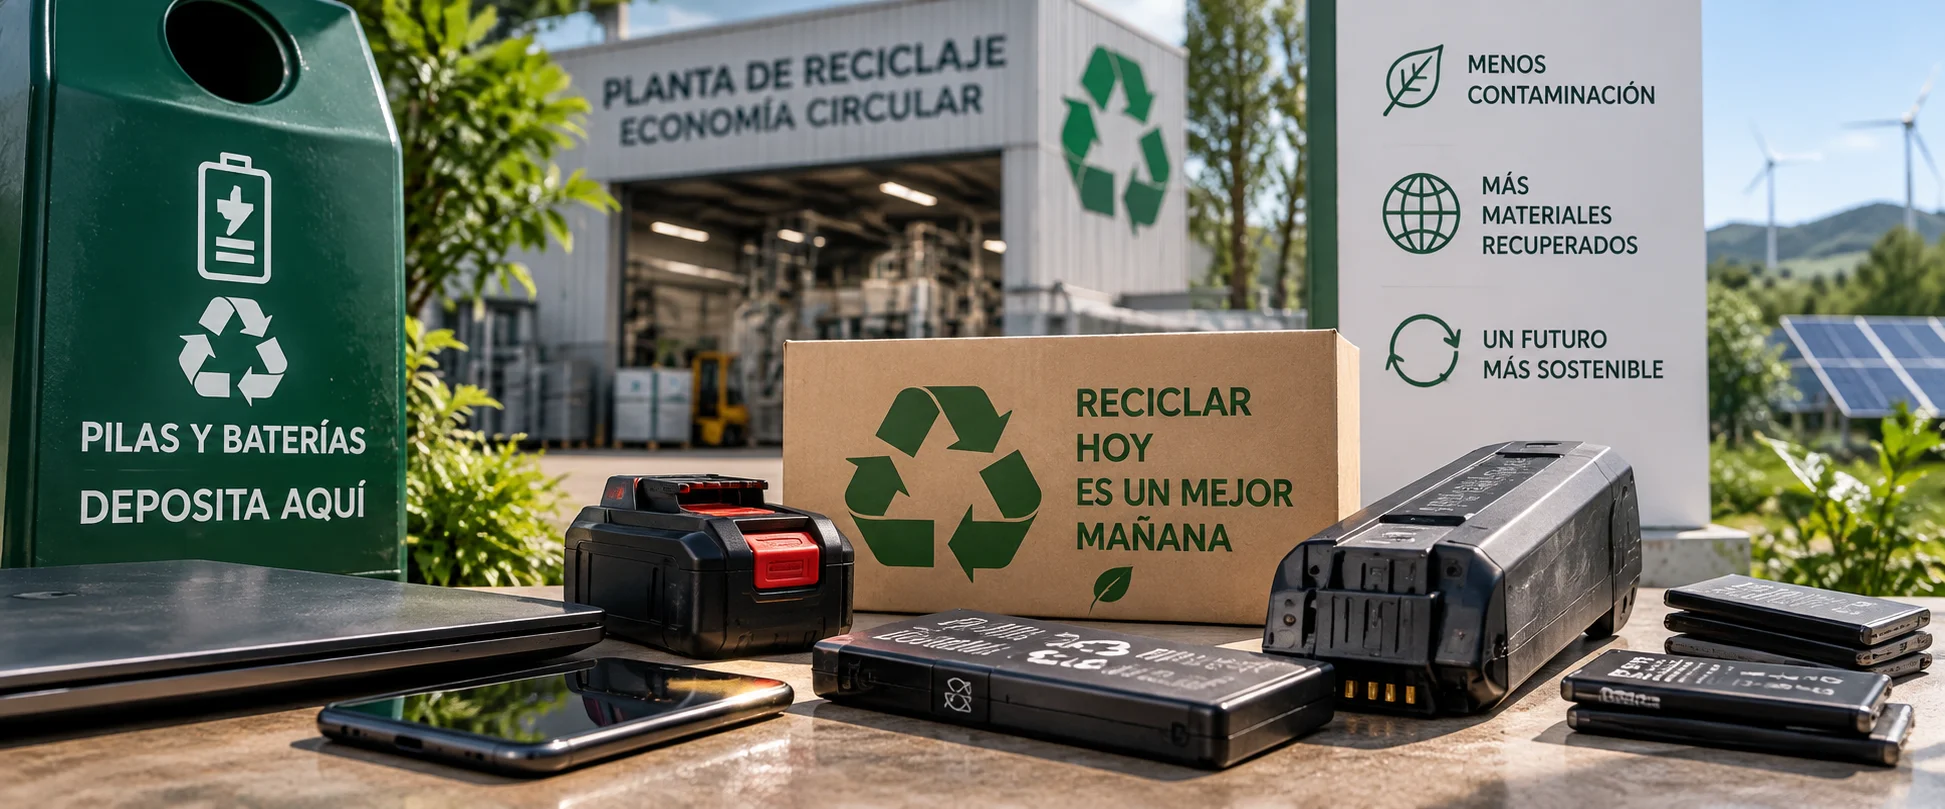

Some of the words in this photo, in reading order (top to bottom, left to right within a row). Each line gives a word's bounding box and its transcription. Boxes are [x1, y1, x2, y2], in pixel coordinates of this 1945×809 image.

[603, 65, 737, 109] PLANTA
[746, 58, 793, 92] DE
[804, 34, 1008, 86] RECICLAJE
[1468, 54, 1546, 74] MENOS
[1467, 81, 1655, 105] CONTAMINACIÓN
[619, 98, 796, 147] ECONOMÍA
[806, 82, 982, 128] CIRCULAR
[1482, 172, 1529, 195] MÁS
[1482, 205, 1612, 225] MATERIALES
[1482, 235, 1638, 255] RECUPERADOS
[1483, 329, 1514, 349] UN
[1521, 329, 1608, 349] FUTURO
[1483, 356, 1531, 380] MÁS
[1537, 359, 1664, 380] SOSTENIBLE
[1076, 386, 1252, 418] RECICLAR
[81, 421, 180, 453] PILAS
[189, 423, 213, 454] Y
[223, 418, 366, 455] BATERÍAS
[1076, 432, 1154, 463] HOY
[80, 488, 271, 525] DEPOSITA
[280, 479, 367, 522] AQUÍ
[1077, 477, 1113, 507] ES
[1124, 477, 1170, 507] UN
[1181, 478, 1294, 508] MEJOR
[1076, 515, 1233, 553] MAÑANA
